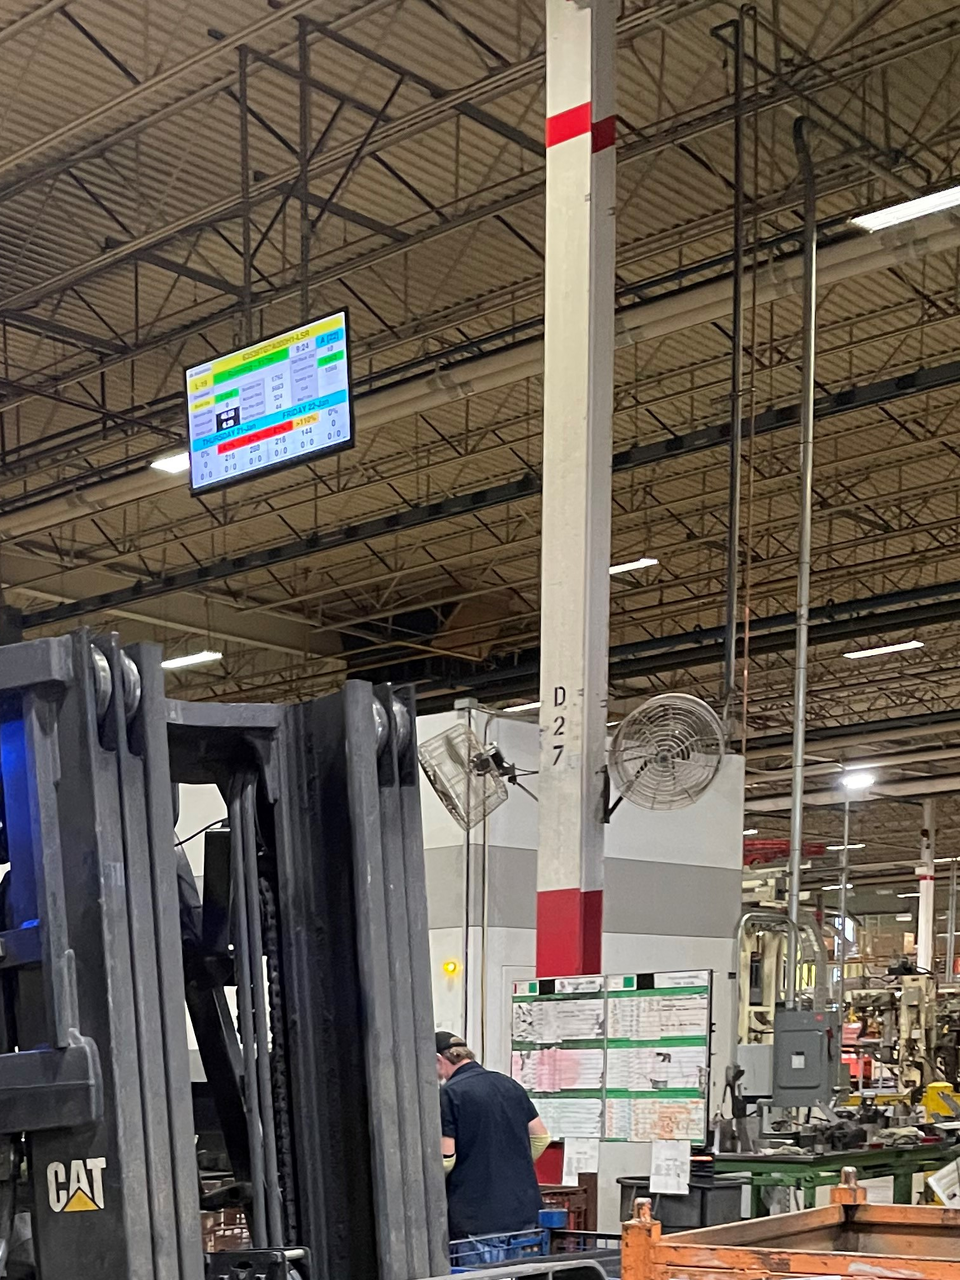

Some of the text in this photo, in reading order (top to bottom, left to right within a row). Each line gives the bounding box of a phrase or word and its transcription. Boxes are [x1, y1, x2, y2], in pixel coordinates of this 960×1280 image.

[282, 406, 306, 419] FRIDAY
[202, 430, 236, 446] THURSDAY
[553, 686, 566, 766] D27
[47, 1157, 106, 1212] CAT
